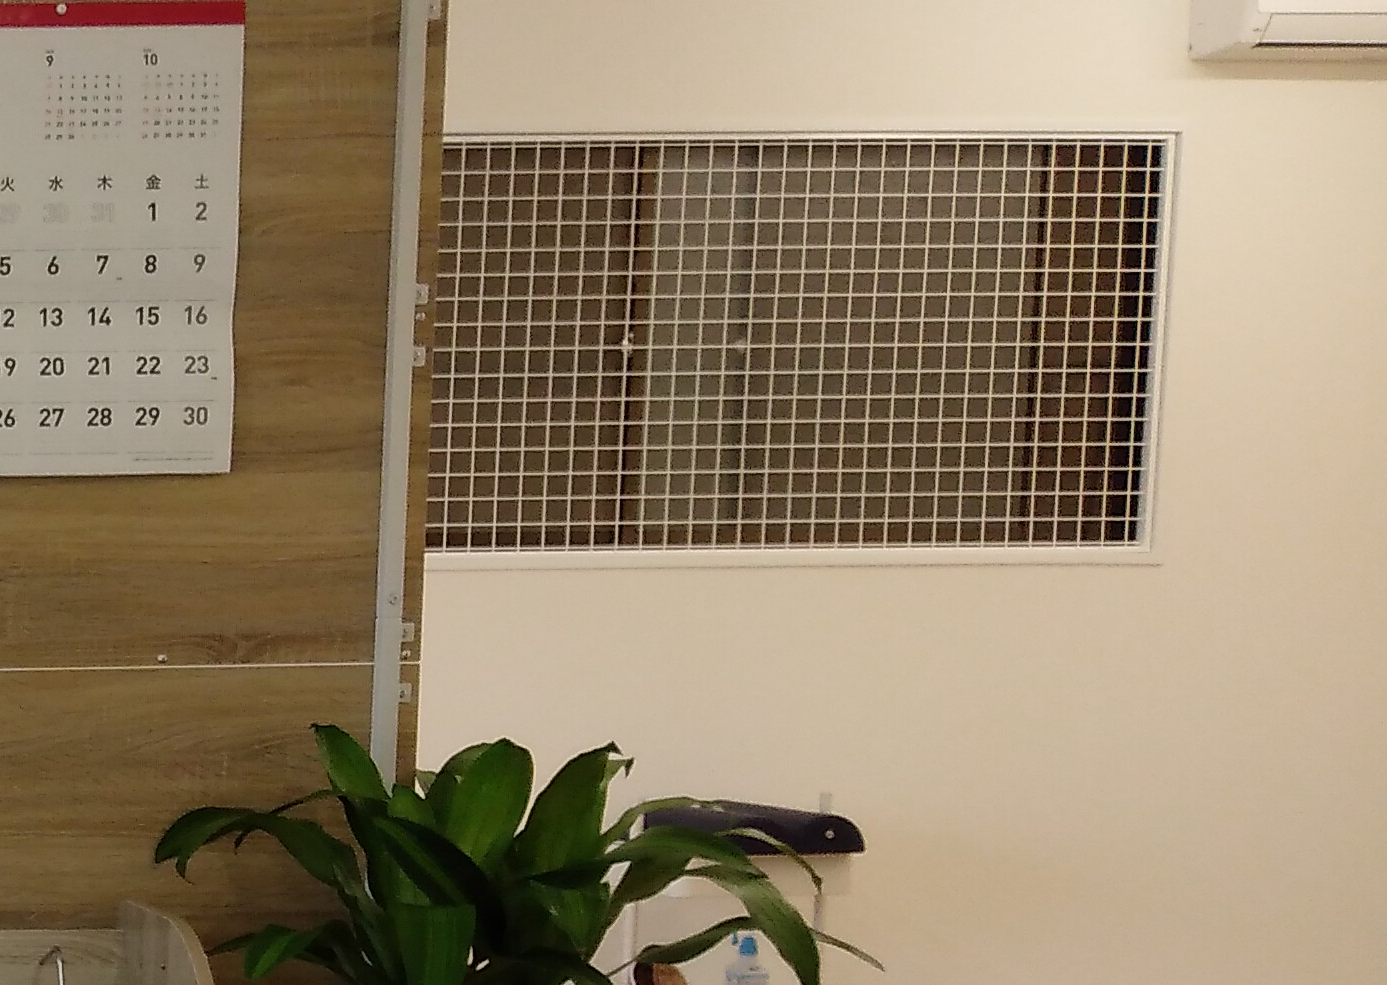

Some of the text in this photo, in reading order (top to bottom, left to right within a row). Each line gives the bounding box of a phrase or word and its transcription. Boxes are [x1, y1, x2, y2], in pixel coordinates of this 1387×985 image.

[46, 55, 53, 66] 9
[144, 53, 157, 65] 10
[1, 177, 14, 191] 火
[49, 176, 63, 191] 水
[98, 175, 112, 190] 木
[146, 175, 161, 189] 金
[195, 174, 209, 189] 土
[148, 203, 156, 221] 1
[196, 202, 207, 220] 2
[0, 257, 11, 275] 5
[48, 256, 59, 275] 6
[97, 255, 108, 274] 7
[145, 255, 156, 273] 8
[194, 254, 205, 272] 9
[40, 308, 62, 327] 13
[88, 307, 111, 326] 14
[136, 307, 159, 325] 15
[185, 306, 207, 325] 16
[40, 357, 64, 375] 20
[88, 357, 109, 375] 21
[136, 356, 160, 374] 22
[185, 356, 209, 374] 23
[40, 408, 64, 427] 27
[87, 408, 112, 426] 28
[135, 407, 159, 426] 29
[184, 407, 208, 425] 30
